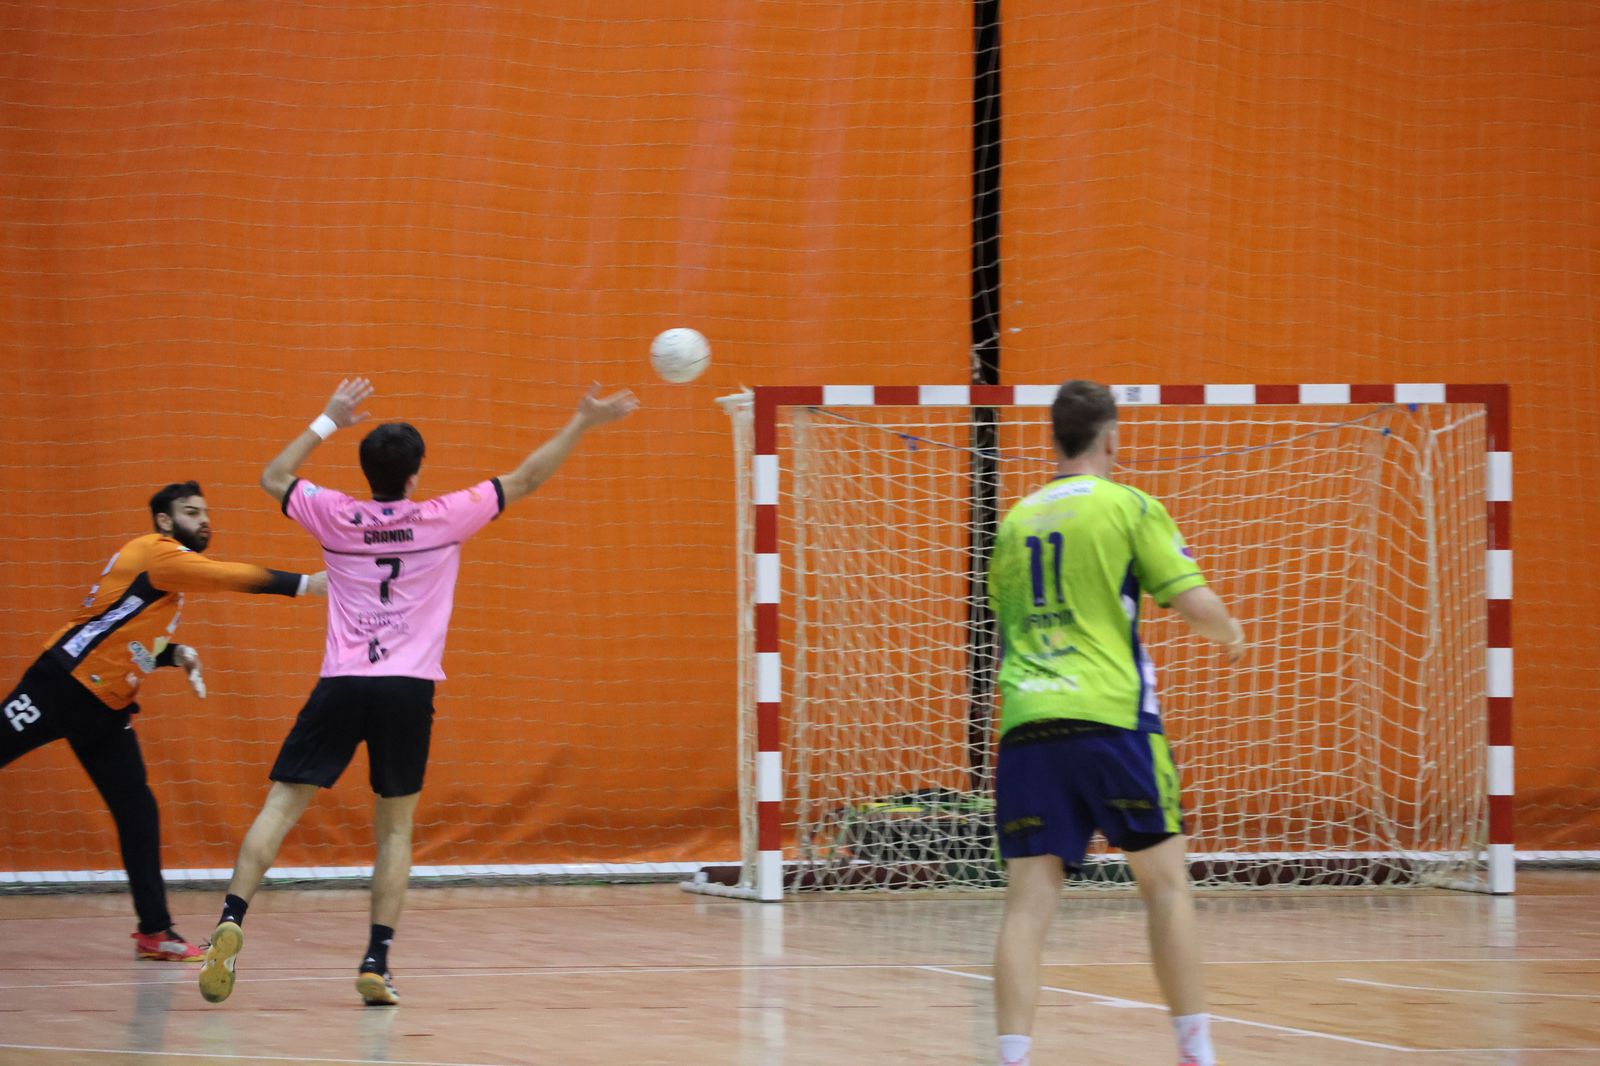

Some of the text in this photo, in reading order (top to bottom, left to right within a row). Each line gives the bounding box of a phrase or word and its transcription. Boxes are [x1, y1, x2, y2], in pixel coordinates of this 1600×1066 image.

[375, 557, 401, 605] 7
[1025, 531, 1065, 607] 11
[4, 693, 41, 732] 22
